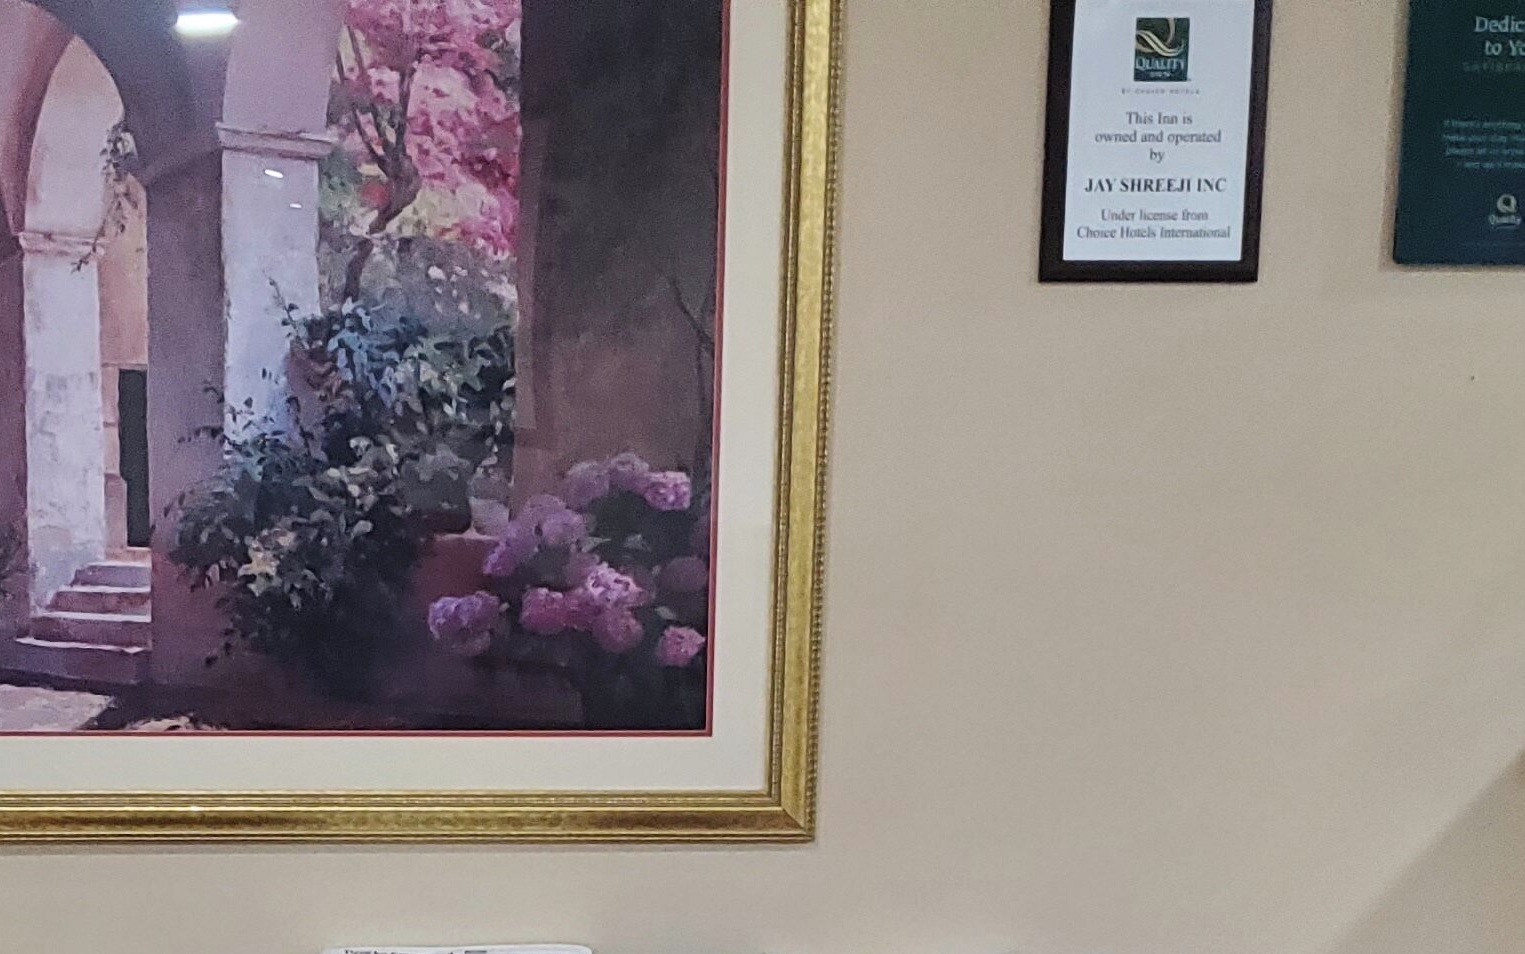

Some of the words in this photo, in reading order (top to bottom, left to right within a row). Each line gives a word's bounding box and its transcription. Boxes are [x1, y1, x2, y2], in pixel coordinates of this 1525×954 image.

[1485, 40, 1502, 55] to
[1135, 56, 1185, 71] QUALITY
[1126, 112, 1154, 125] This
[1158, 112, 1178, 125] Inn
[1182, 112, 1193, 125] is
[1094, 130, 1137, 143] owned
[1140, 130, 1164, 143] and
[1167, 130, 1222, 146] operated
[1149, 148, 1165, 163] by
[1085, 178, 1116, 192] JAY
[1119, 178, 1191, 192] SHREEJI
[1196, 177, 1227, 192] INC
[1101, 208, 1135, 221] Under
[1139, 208, 1178, 221] license
[1182, 208, 1209, 221] from
[1076, 225, 1117, 239] Choice
[1120, 225, 1157, 239] Hotels
[1160, 225, 1231, 239] International
